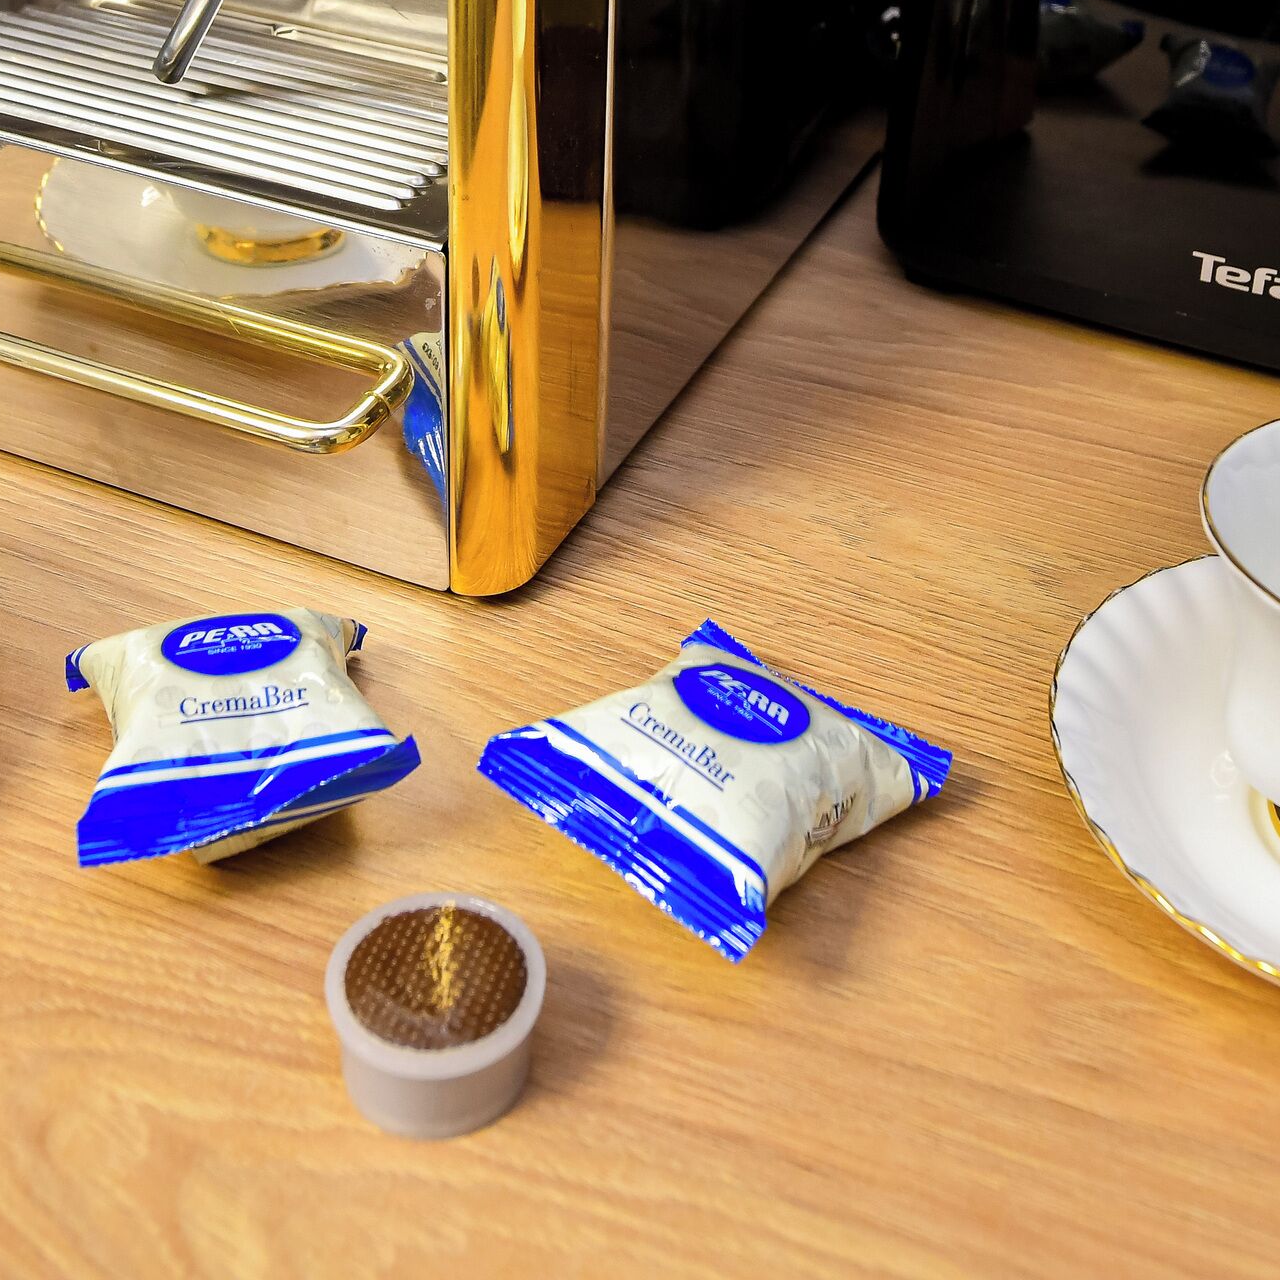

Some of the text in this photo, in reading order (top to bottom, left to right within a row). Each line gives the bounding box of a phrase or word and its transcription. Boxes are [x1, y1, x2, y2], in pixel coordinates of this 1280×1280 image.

[178, 622, 283, 648] PERA
[179, 684, 308, 718] CremaBar
[698, 669, 790, 727] PERA
[628, 701, 736, 784] CremaBar
